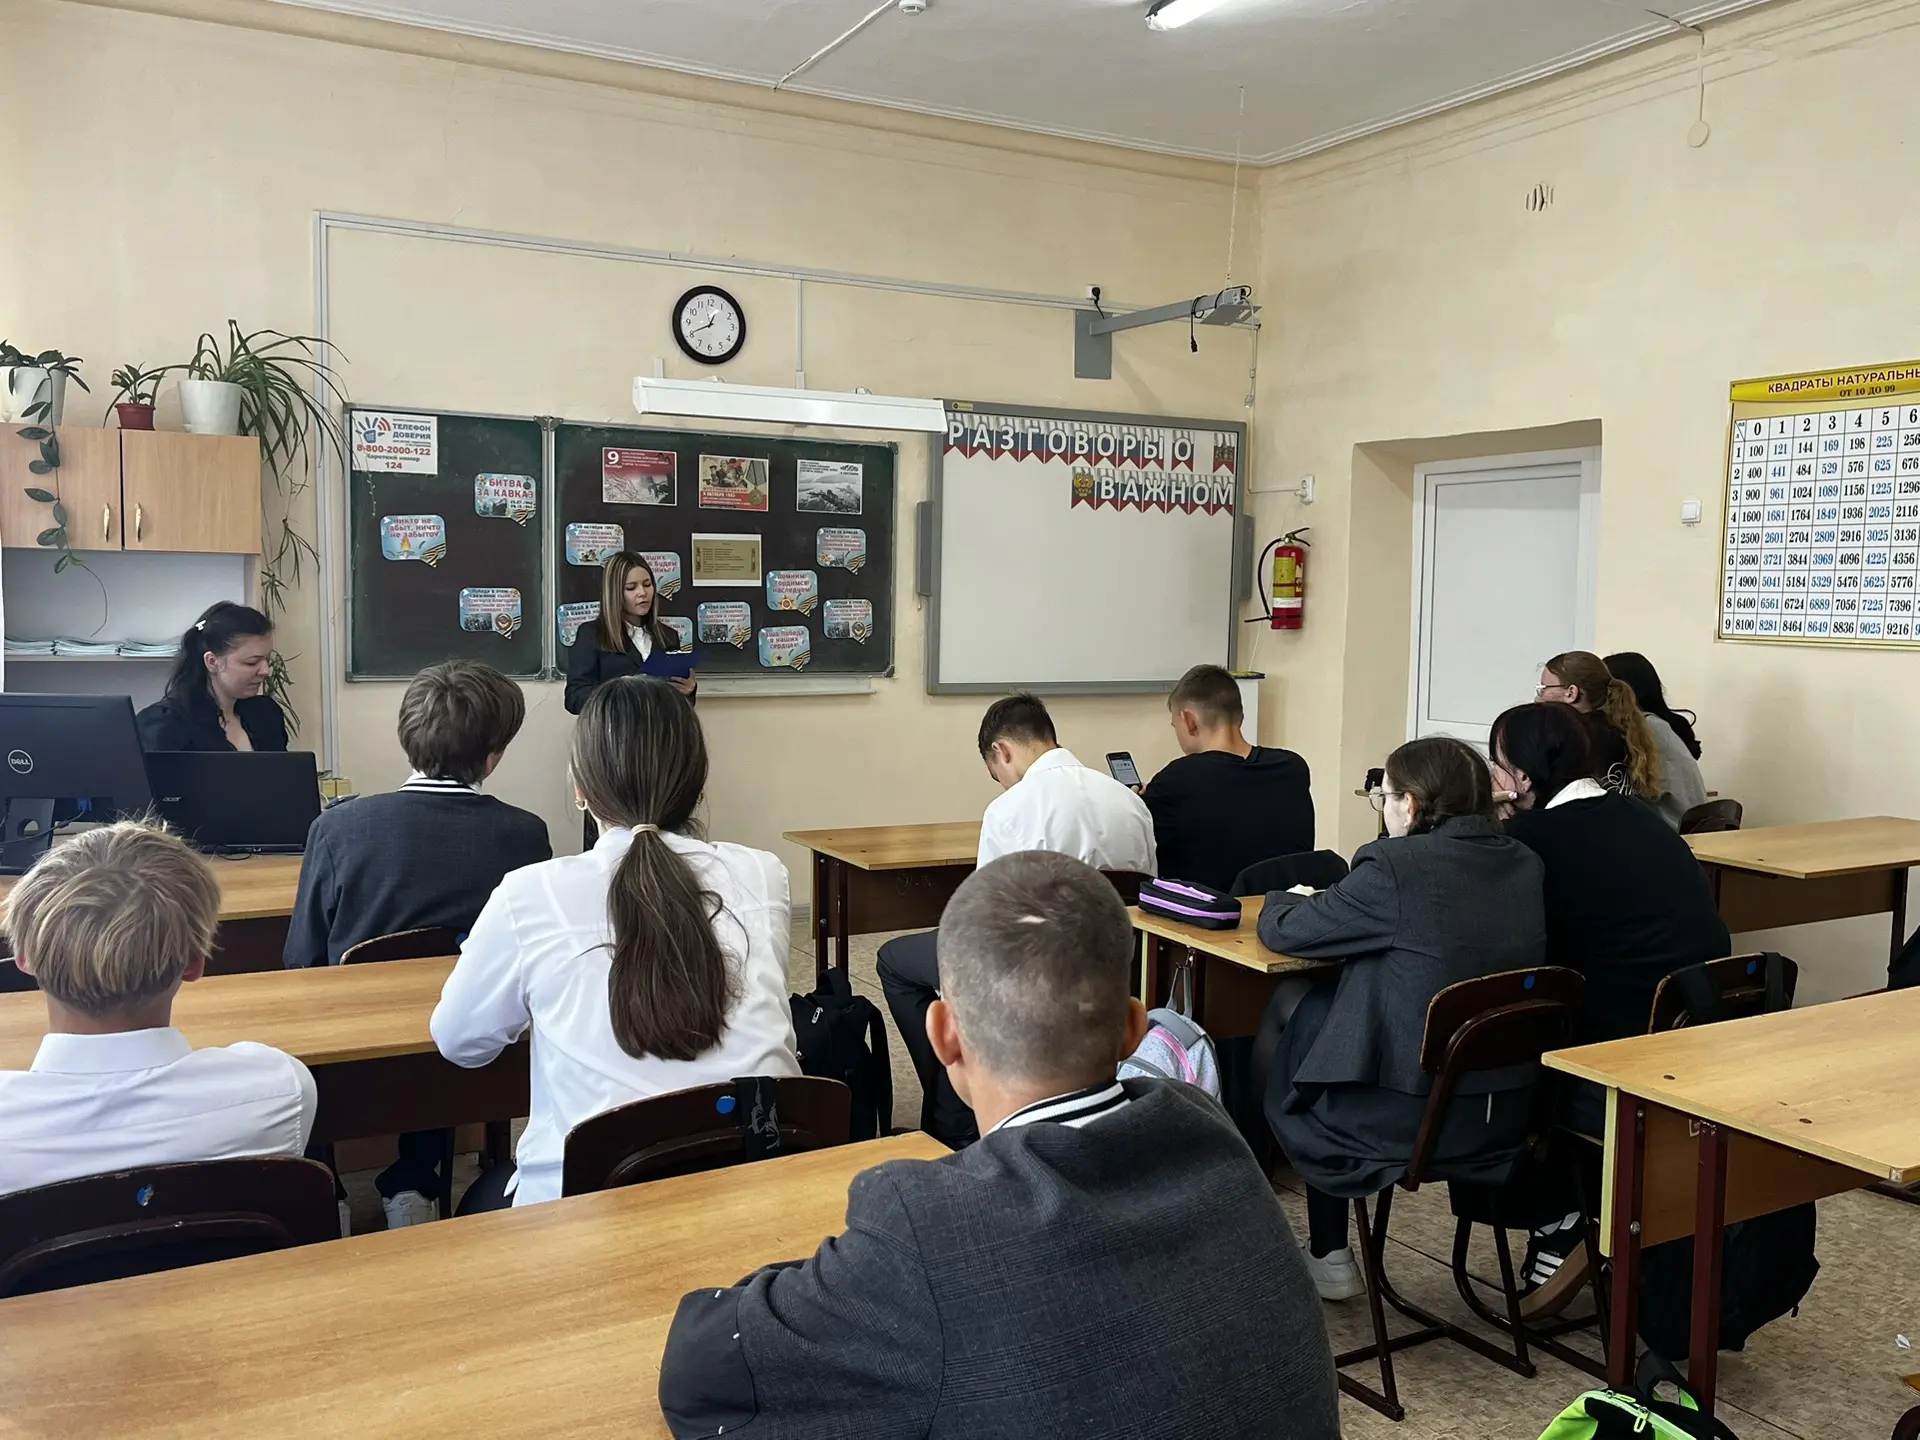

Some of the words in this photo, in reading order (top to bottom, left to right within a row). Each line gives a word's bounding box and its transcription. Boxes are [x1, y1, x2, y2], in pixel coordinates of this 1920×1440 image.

[708, 299, 715, 307] 12
[720, 303, 723, 311] 1
[690, 308, 697, 316] 10
[726, 312, 732, 321] 2
[686, 318, 691, 326] 9
[730, 323, 735, 332] 3
[689, 330, 695, 339] 8
[697, 339, 702, 347] 7
[1768, 377, 1833, 393] КВАДРАТЫ
[1839, 389, 1852, 398] ОТ
[1855, 388, 1866, 396] 10
[1867, 386, 1882, 396] ДО
[1884, 385, 1896, 393] 99
[392, 423, 431, 432] ТЕЛЕФОН
[1754, 422, 1762, 436] 0
[1779, 420, 1785, 434] 1
[1803, 418, 1811, 432] 2
[1828, 415, 1836, 430] 3
[1854, 413, 1862, 428] 4
[1882, 411, 1890, 426] 5
[1909, 408, 1918, 424] 6
[392, 431, 431, 440] ДОВЕРИЯ
[948, 421, 1164, 460] РАЗГОВОРЫ
[1173, 437, 1192, 461] О
[356, 443, 431, 456] 8-800-2000-122
[1736, 447, 1741, 458] 1
[1749, 444, 1764, 457] 100
[1773, 443, 1787, 455] 121
[1798, 441, 1813, 453] 144
[1824, 439, 1839, 452] 169
[1876, 435, 1893, 448] 225
[1903, 433, 1920, 446] 256
[607, 450, 619, 465] 9
[385, 461, 403, 469] 124
[1733, 468, 1740, 479] 2
[1747, 467, 1762, 479] 400
[1771, 465, 1786, 477] 441
[1796, 464, 1811, 476] 484
[1821, 462, 1838, 475] 529
[1847, 461, 1864, 473] 576
[1874, 459, 1891, 472] 625
[1901, 457, 1919, 470] 676
[489, 479, 522, 488] БИТВА
[477, 487, 489, 496] ЗА
[493, 489, 534, 498] КАВКАЗ
[1100, 476, 1234, 506] ВАЖНОМ
[1732, 490, 1739, 501] 3
[1745, 488, 1761, 500] 900
[1769, 487, 1784, 500] 961
[1792, 486, 1812, 499] 1024
[1818, 485, 1839, 497] 1089
[1843, 483, 1865, 496] 1156
[1870, 482, 1892, 495] 1225
[1898, 481, 1920, 494] 1296
[1730, 511, 1737, 523] 4
[1742, 510, 1761, 522] 1600
[1767, 509, 1785, 522] 1681
[1791, 508, 1811, 521] 1764
[1816, 507, 1837, 520] 1849
[1842, 506, 1863, 519] 1936
[1868, 505, 1891, 518] 2025
[1895, 504, 1918, 518] 2116
[1729, 533, 1736, 544] 5
[1740, 532, 1760, 544] 2500
[1764, 532, 1784, 544] 2601
[1789, 531, 1809, 543] 2704
[1814, 530, 1835, 543] 2809
[1840, 529, 1861, 542] 2916
[1867, 529, 1889, 541] 3025
[1894, 528, 1917, 541] 3136
[1728, 554, 1734, 566] 6
[1739, 554, 1759, 566] 3600
[1763, 554, 1782, 566] 3721
[1787, 553, 1808, 566] 3844
[1812, 553, 1834, 565] 3969
[1838, 552, 1860, 565] 4096
[1865, 552, 1887, 564] 4225
[1892, 552, 1915, 565] 4356
[1727, 576, 1733, 587] 7
[1738, 575, 1757, 588] 4900
[1761, 576, 1781, 588] 5041
[1785, 576, 1806, 588] 5184
[1811, 576, 1832, 588] 5329
[1836, 576, 1858, 588] 5476
[1863, 576, 1885, 588] 5625
[1890, 576, 1913, 588] 5776
[1725, 597, 1732, 609] 8
[1736, 597, 1756, 609] 6400
[1760, 597, 1779, 609] 6561
[1784, 598, 1804, 610] 6724
[1809, 598, 1830, 611] 6889
[1835, 599, 1857, 611] 7056
[1862, 599, 1884, 611] 7225
[1889, 600, 1912, 612] 7396
[1725, 618, 1731, 630] 9
[1735, 618, 1755, 631] 8100
[1758, 619, 1778, 631] 8281
[1782, 620, 1802, 632] 8464
[1807, 621, 1828, 633] 8649
[1832, 621, 1854, 634] 8836
[1860, 622, 1881, 634] 9025
[1886, 623, 1909, 635] 9216
